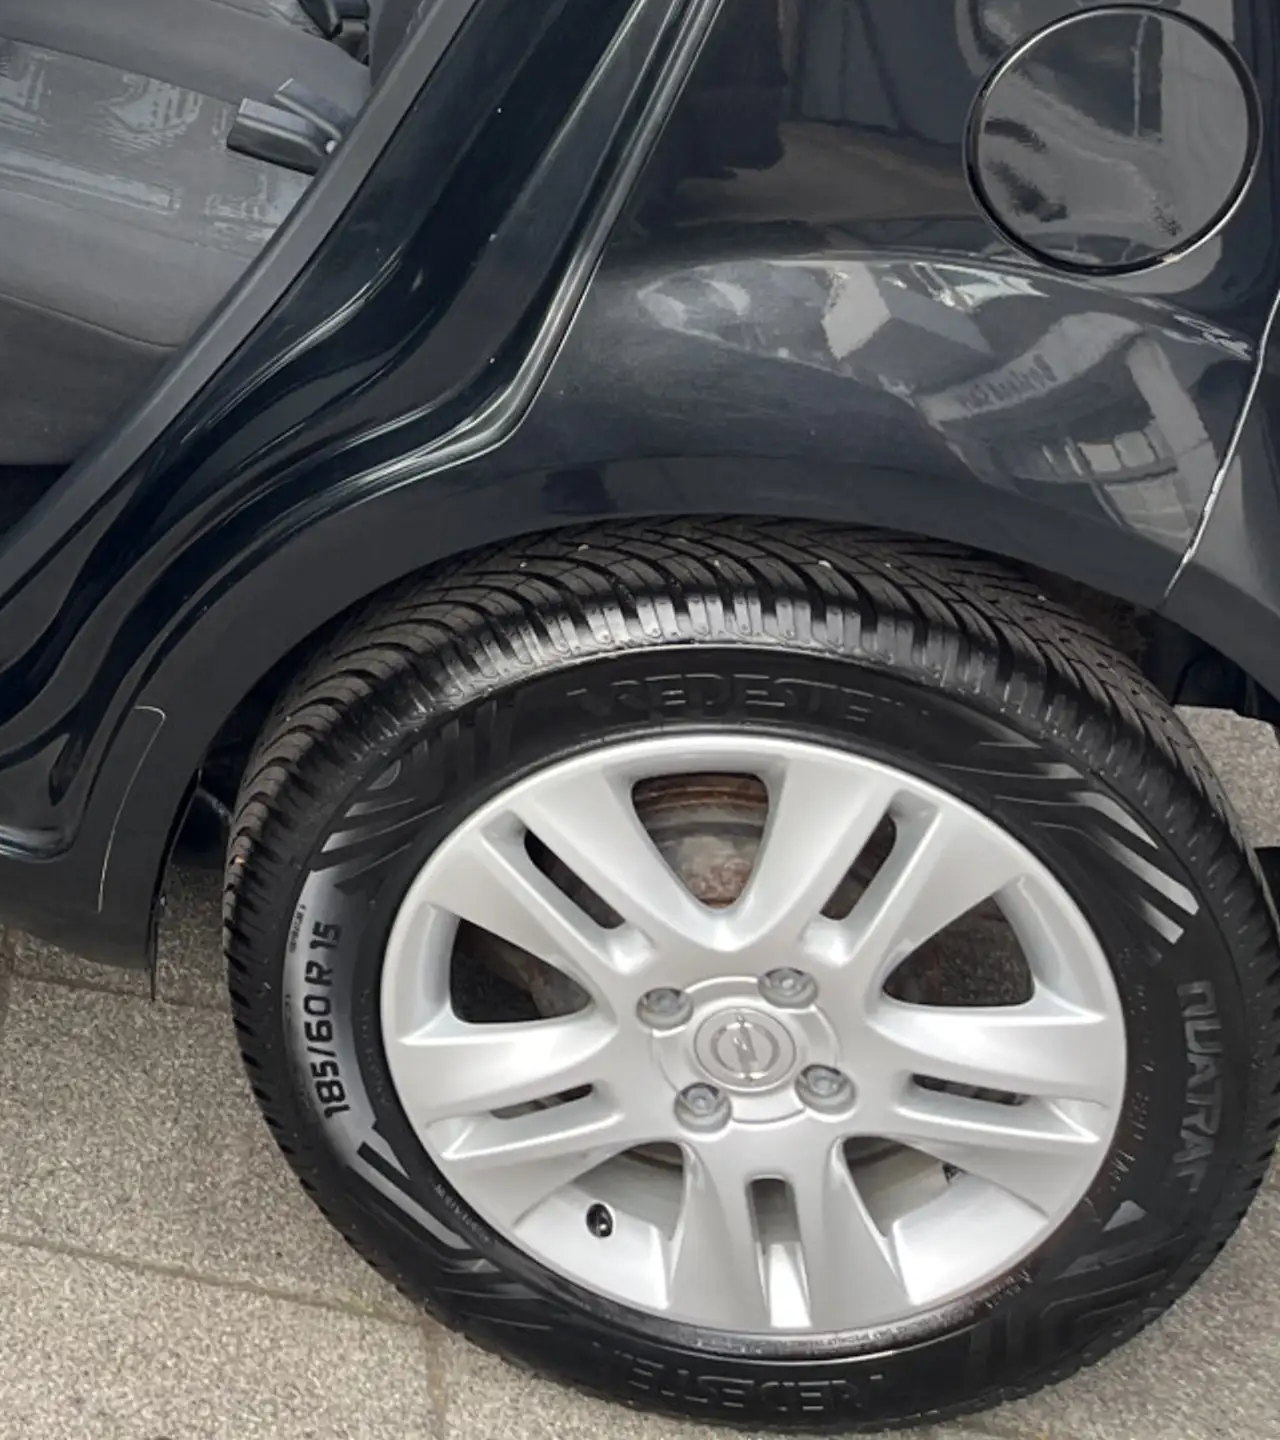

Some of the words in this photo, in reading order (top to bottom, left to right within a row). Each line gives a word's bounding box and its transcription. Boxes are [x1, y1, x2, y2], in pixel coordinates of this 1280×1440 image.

[309, 920, 341, 950] 15
[304, 960, 333, 987] R
[303, 995, 351, 1119] 185/60
